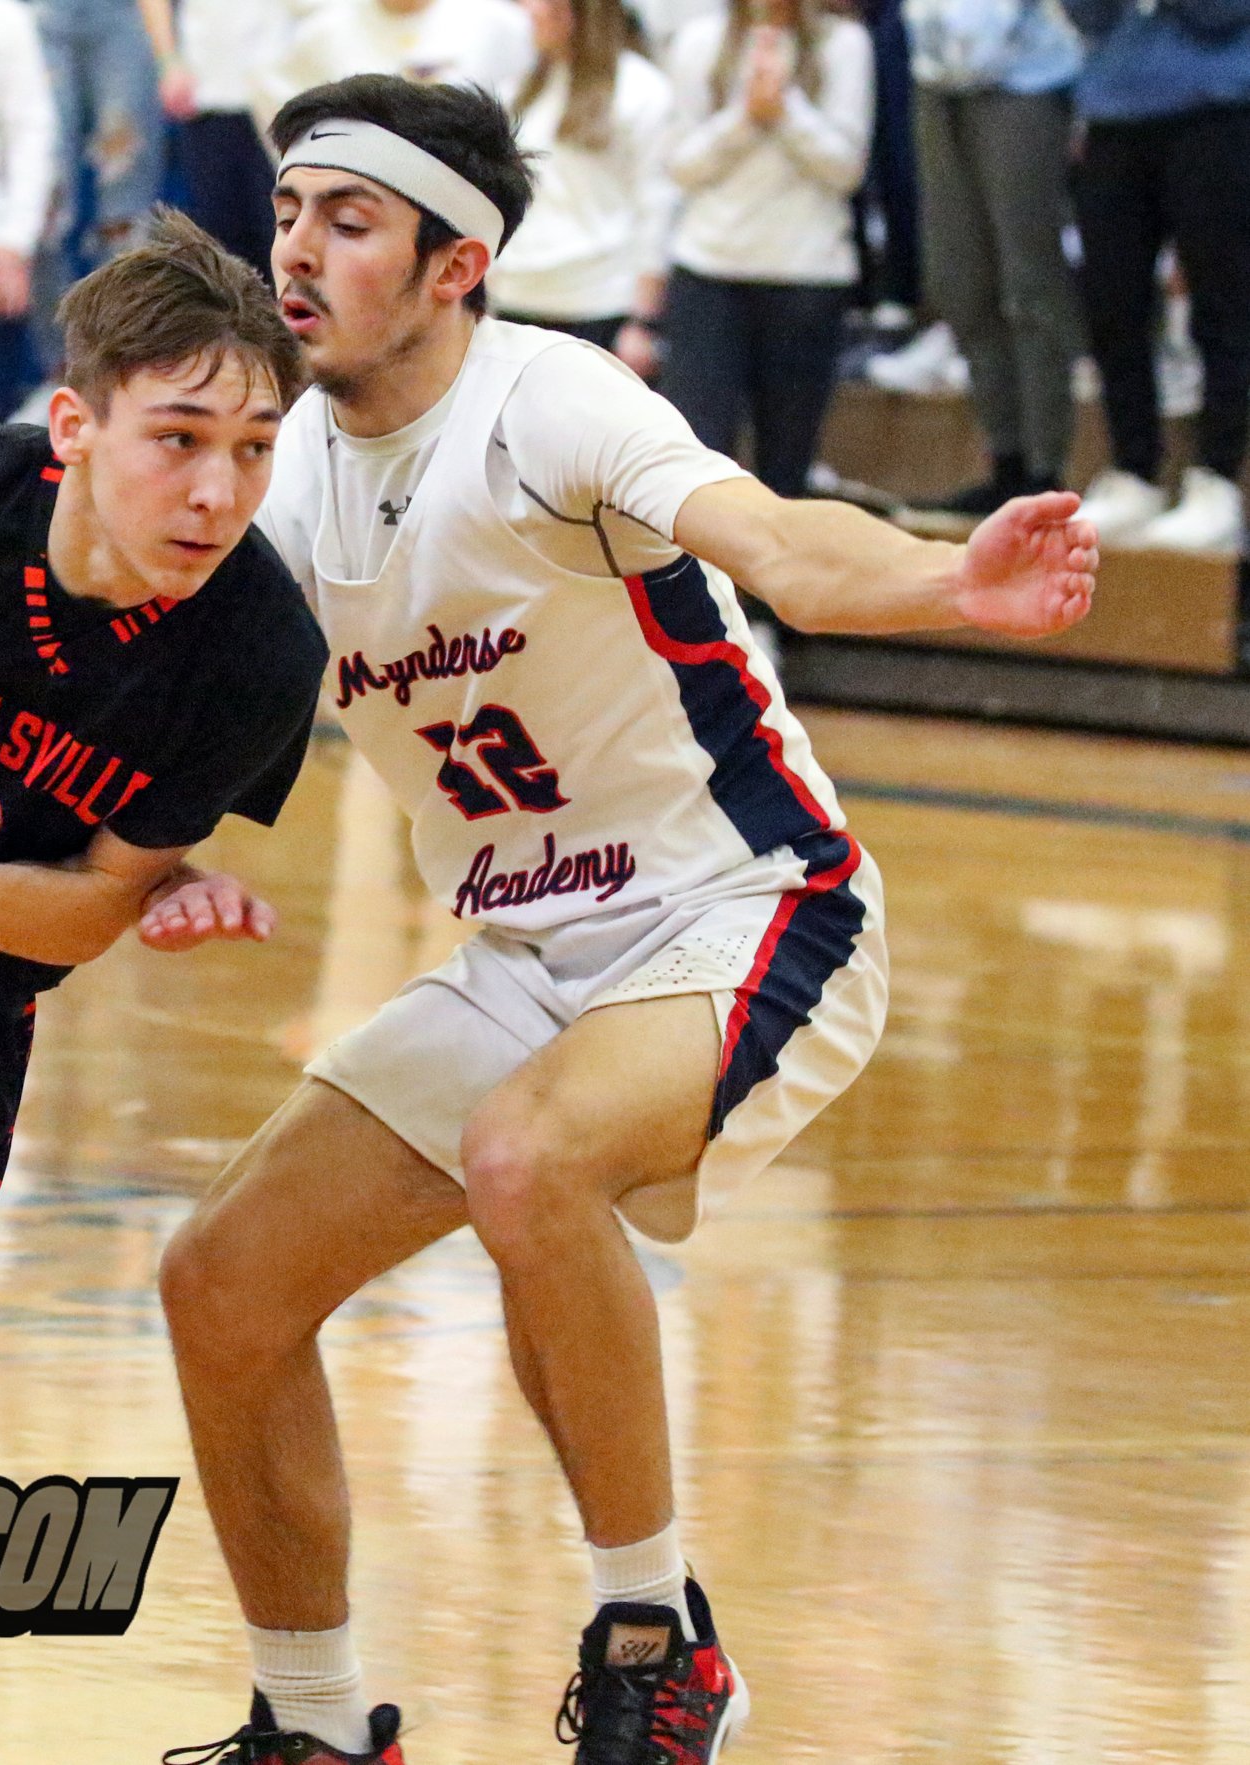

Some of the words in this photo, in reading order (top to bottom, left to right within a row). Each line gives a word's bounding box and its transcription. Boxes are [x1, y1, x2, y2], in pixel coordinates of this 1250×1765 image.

[336, 624, 527, 709] Mynderse
[412, 703, 573, 821] 12
[451, 832, 635, 919] Academy
